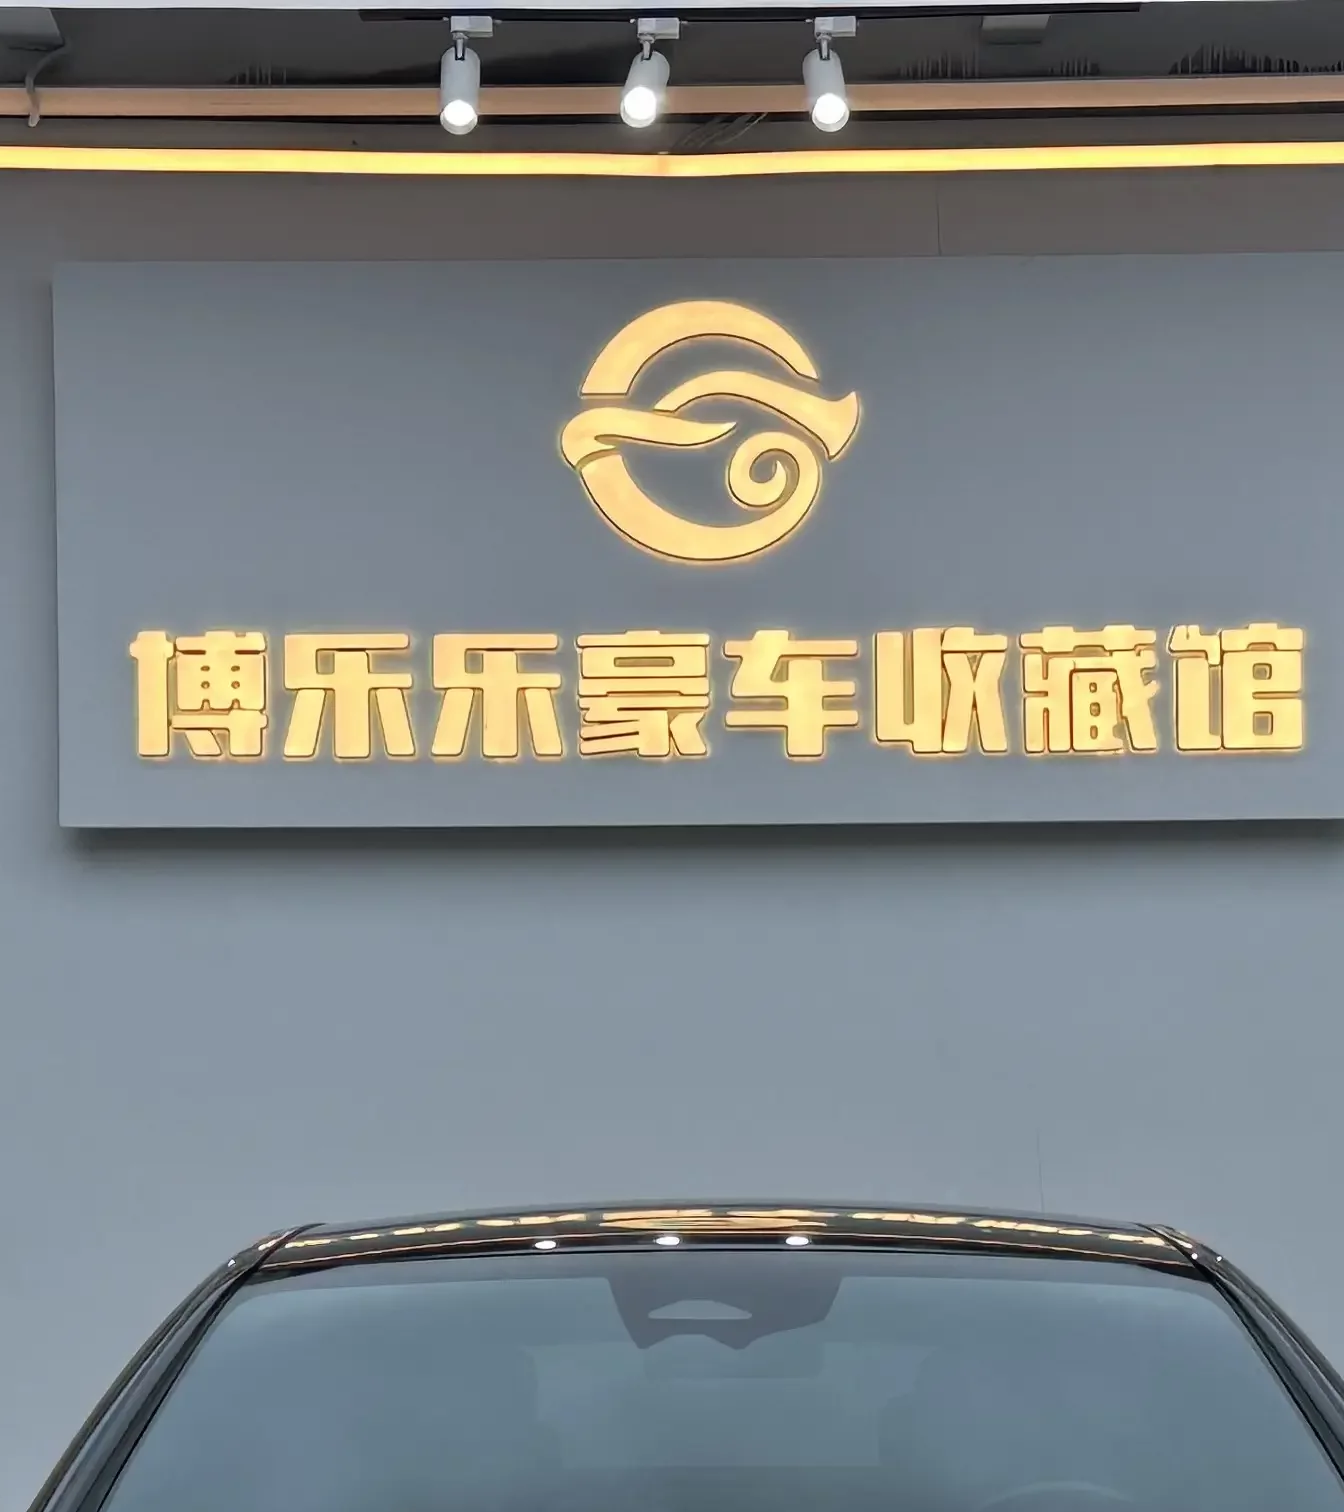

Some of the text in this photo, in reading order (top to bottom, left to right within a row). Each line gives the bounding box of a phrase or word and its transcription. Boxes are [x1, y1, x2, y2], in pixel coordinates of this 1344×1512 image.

[128, 622, 1306, 761] 博乐乐豪车收藏馆
